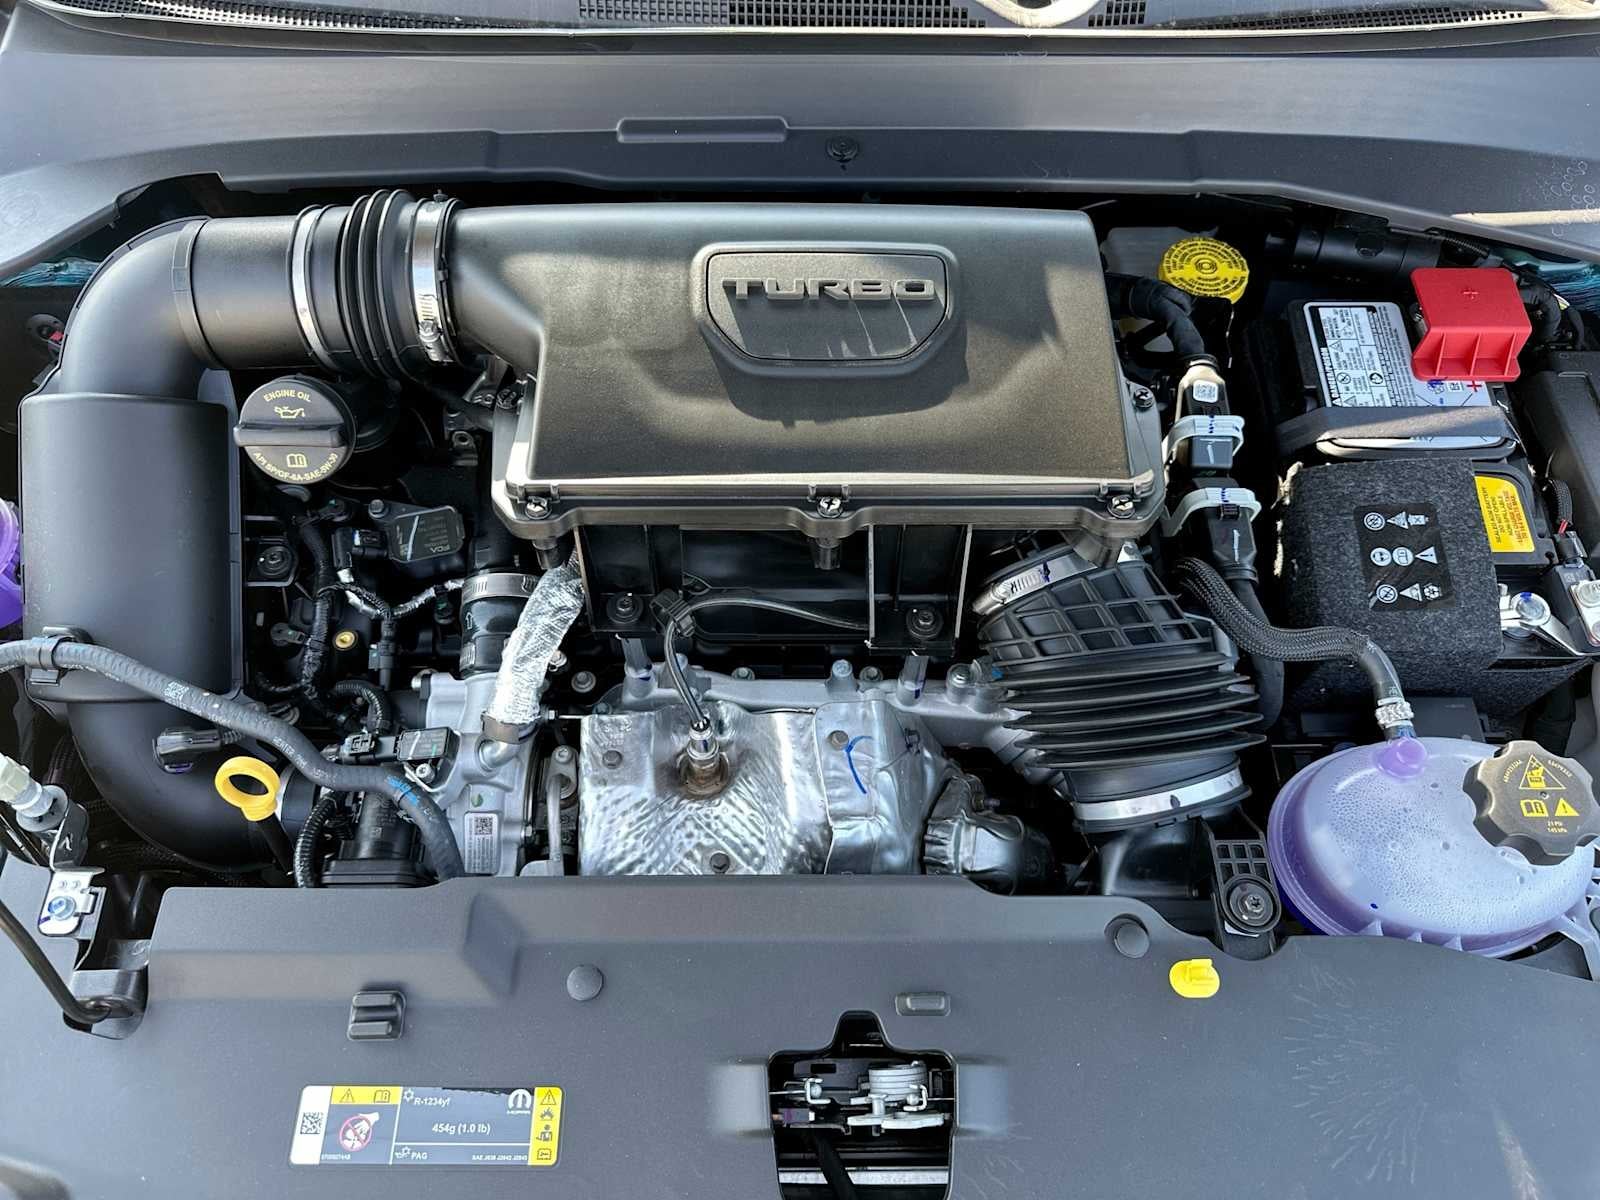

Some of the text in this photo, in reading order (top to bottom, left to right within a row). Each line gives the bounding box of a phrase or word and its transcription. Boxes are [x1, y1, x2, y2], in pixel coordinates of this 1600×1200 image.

[722, 278, 935, 301] TURBO
[263, 389, 311, 403] ENGINE OIL
[252, 452, 267, 466] API
[1481, 487, 1491, 508] BATTERY
[430, 544, 450, 553] FCA
[413, 1096, 450, 1108] R-1234yf
[432, 1123, 491, 1136] 454g (1.0 lb)
[410, 1152, 428, 1161] PAG
